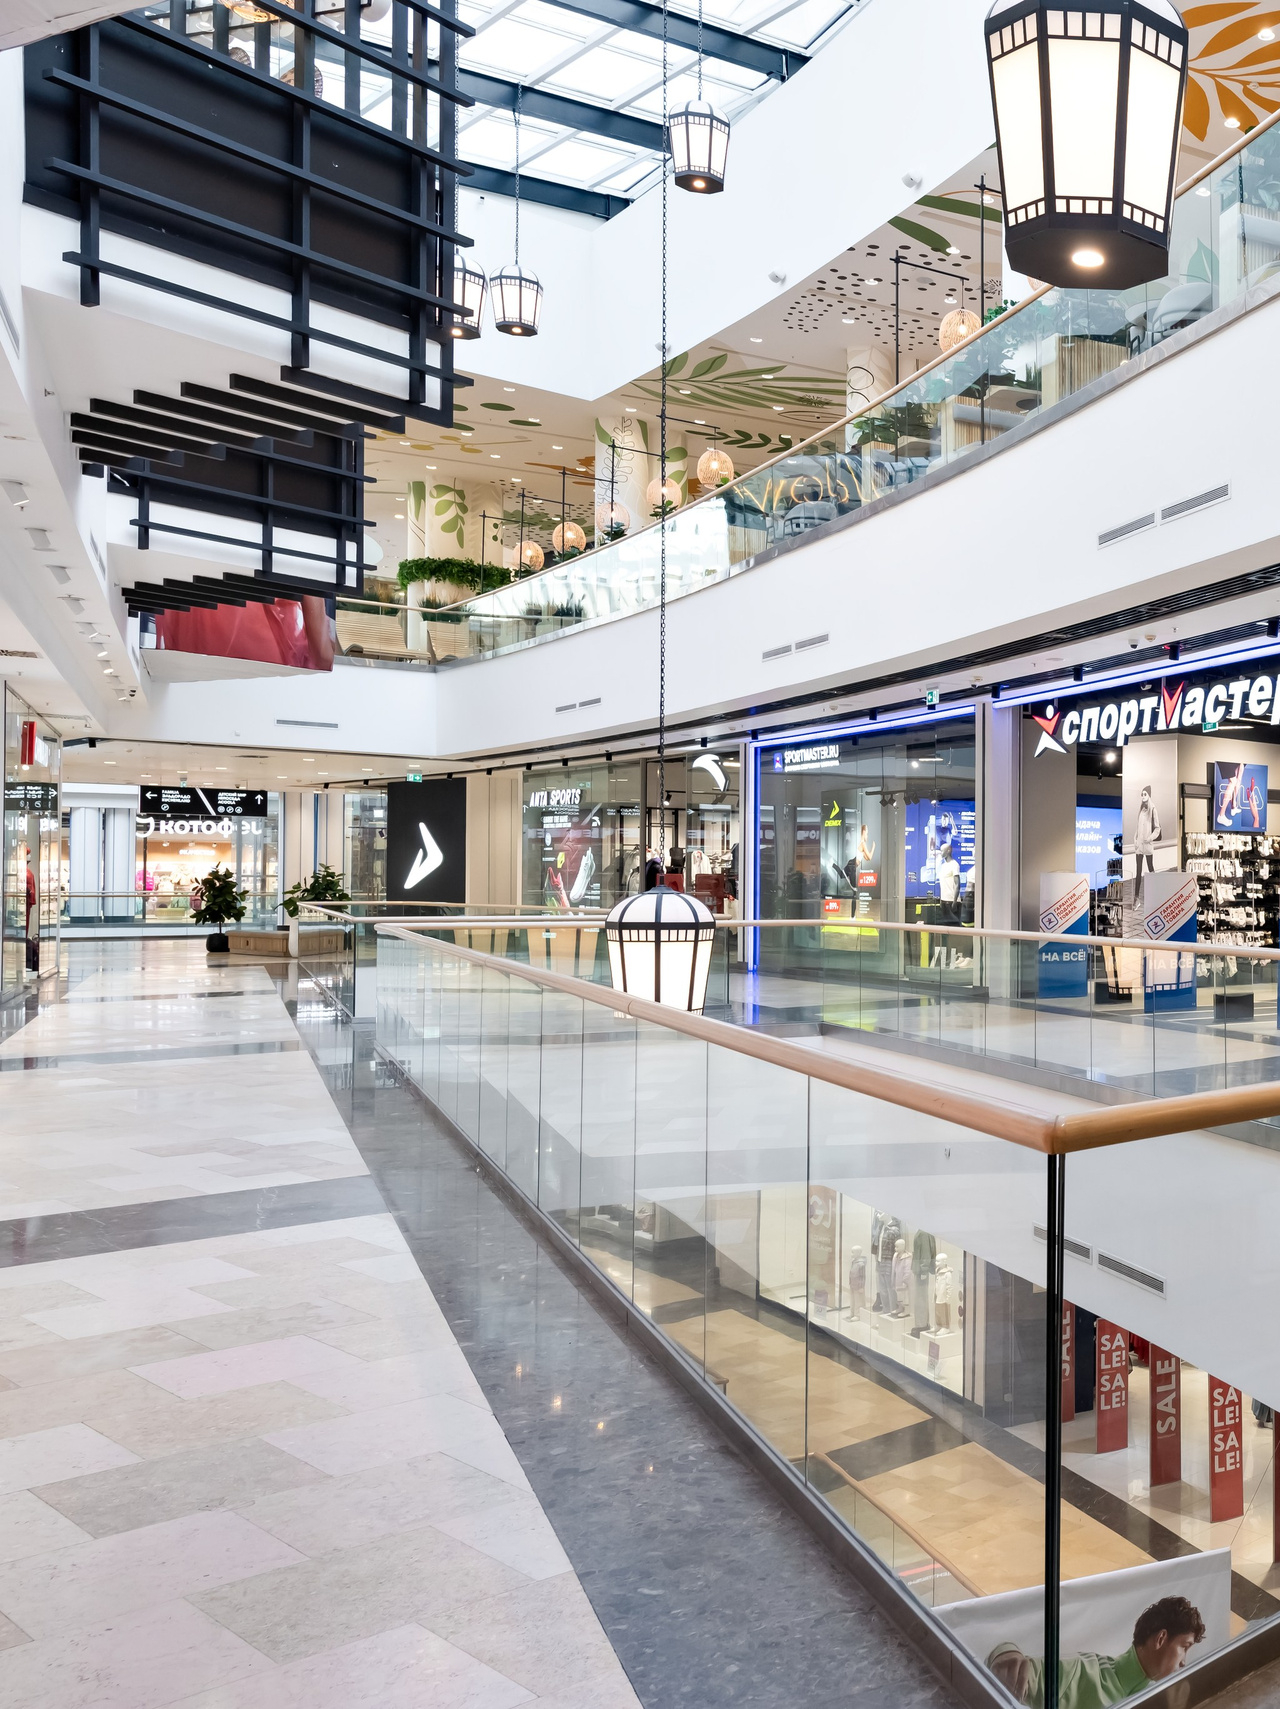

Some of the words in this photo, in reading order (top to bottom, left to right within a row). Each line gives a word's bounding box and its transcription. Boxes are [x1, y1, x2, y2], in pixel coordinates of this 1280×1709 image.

[784, 745, 839, 763] SPORTMASTER.RU
[529, 790, 548, 808] ANTA
[550, 788, 581, 806] SPORTS
[1075, 820, 1101, 830] ыдача
[1053, 892, 1077, 913] ГАРАНТИЯ
[1159, 893, 1185, 916] ГАРАНТИЯ
[1060, 905, 1078, 921] ТОВАРА
[1166, 907, 1185, 924] ТОВАРА
[1042, 952, 1060, 962] НА
[1062, 949, 1086, 961] ВСЁ!
[1149, 959, 1167, 970] НА
[1100, 1332, 1126, 1351] SA
[1100, 1350, 1126, 1370] LE!
[1100, 1373, 1126, 1392] SA
[1100, 1391, 1126, 1411] LE!
[1156, 1357, 1177, 1434] SALE
[1212, 1386, 1239, 1407] SA
[1213, 1405, 1240, 1428] LE!
[1213, 1431, 1240, 1453] SA
[1214, 1450, 1241, 1474] LE!
